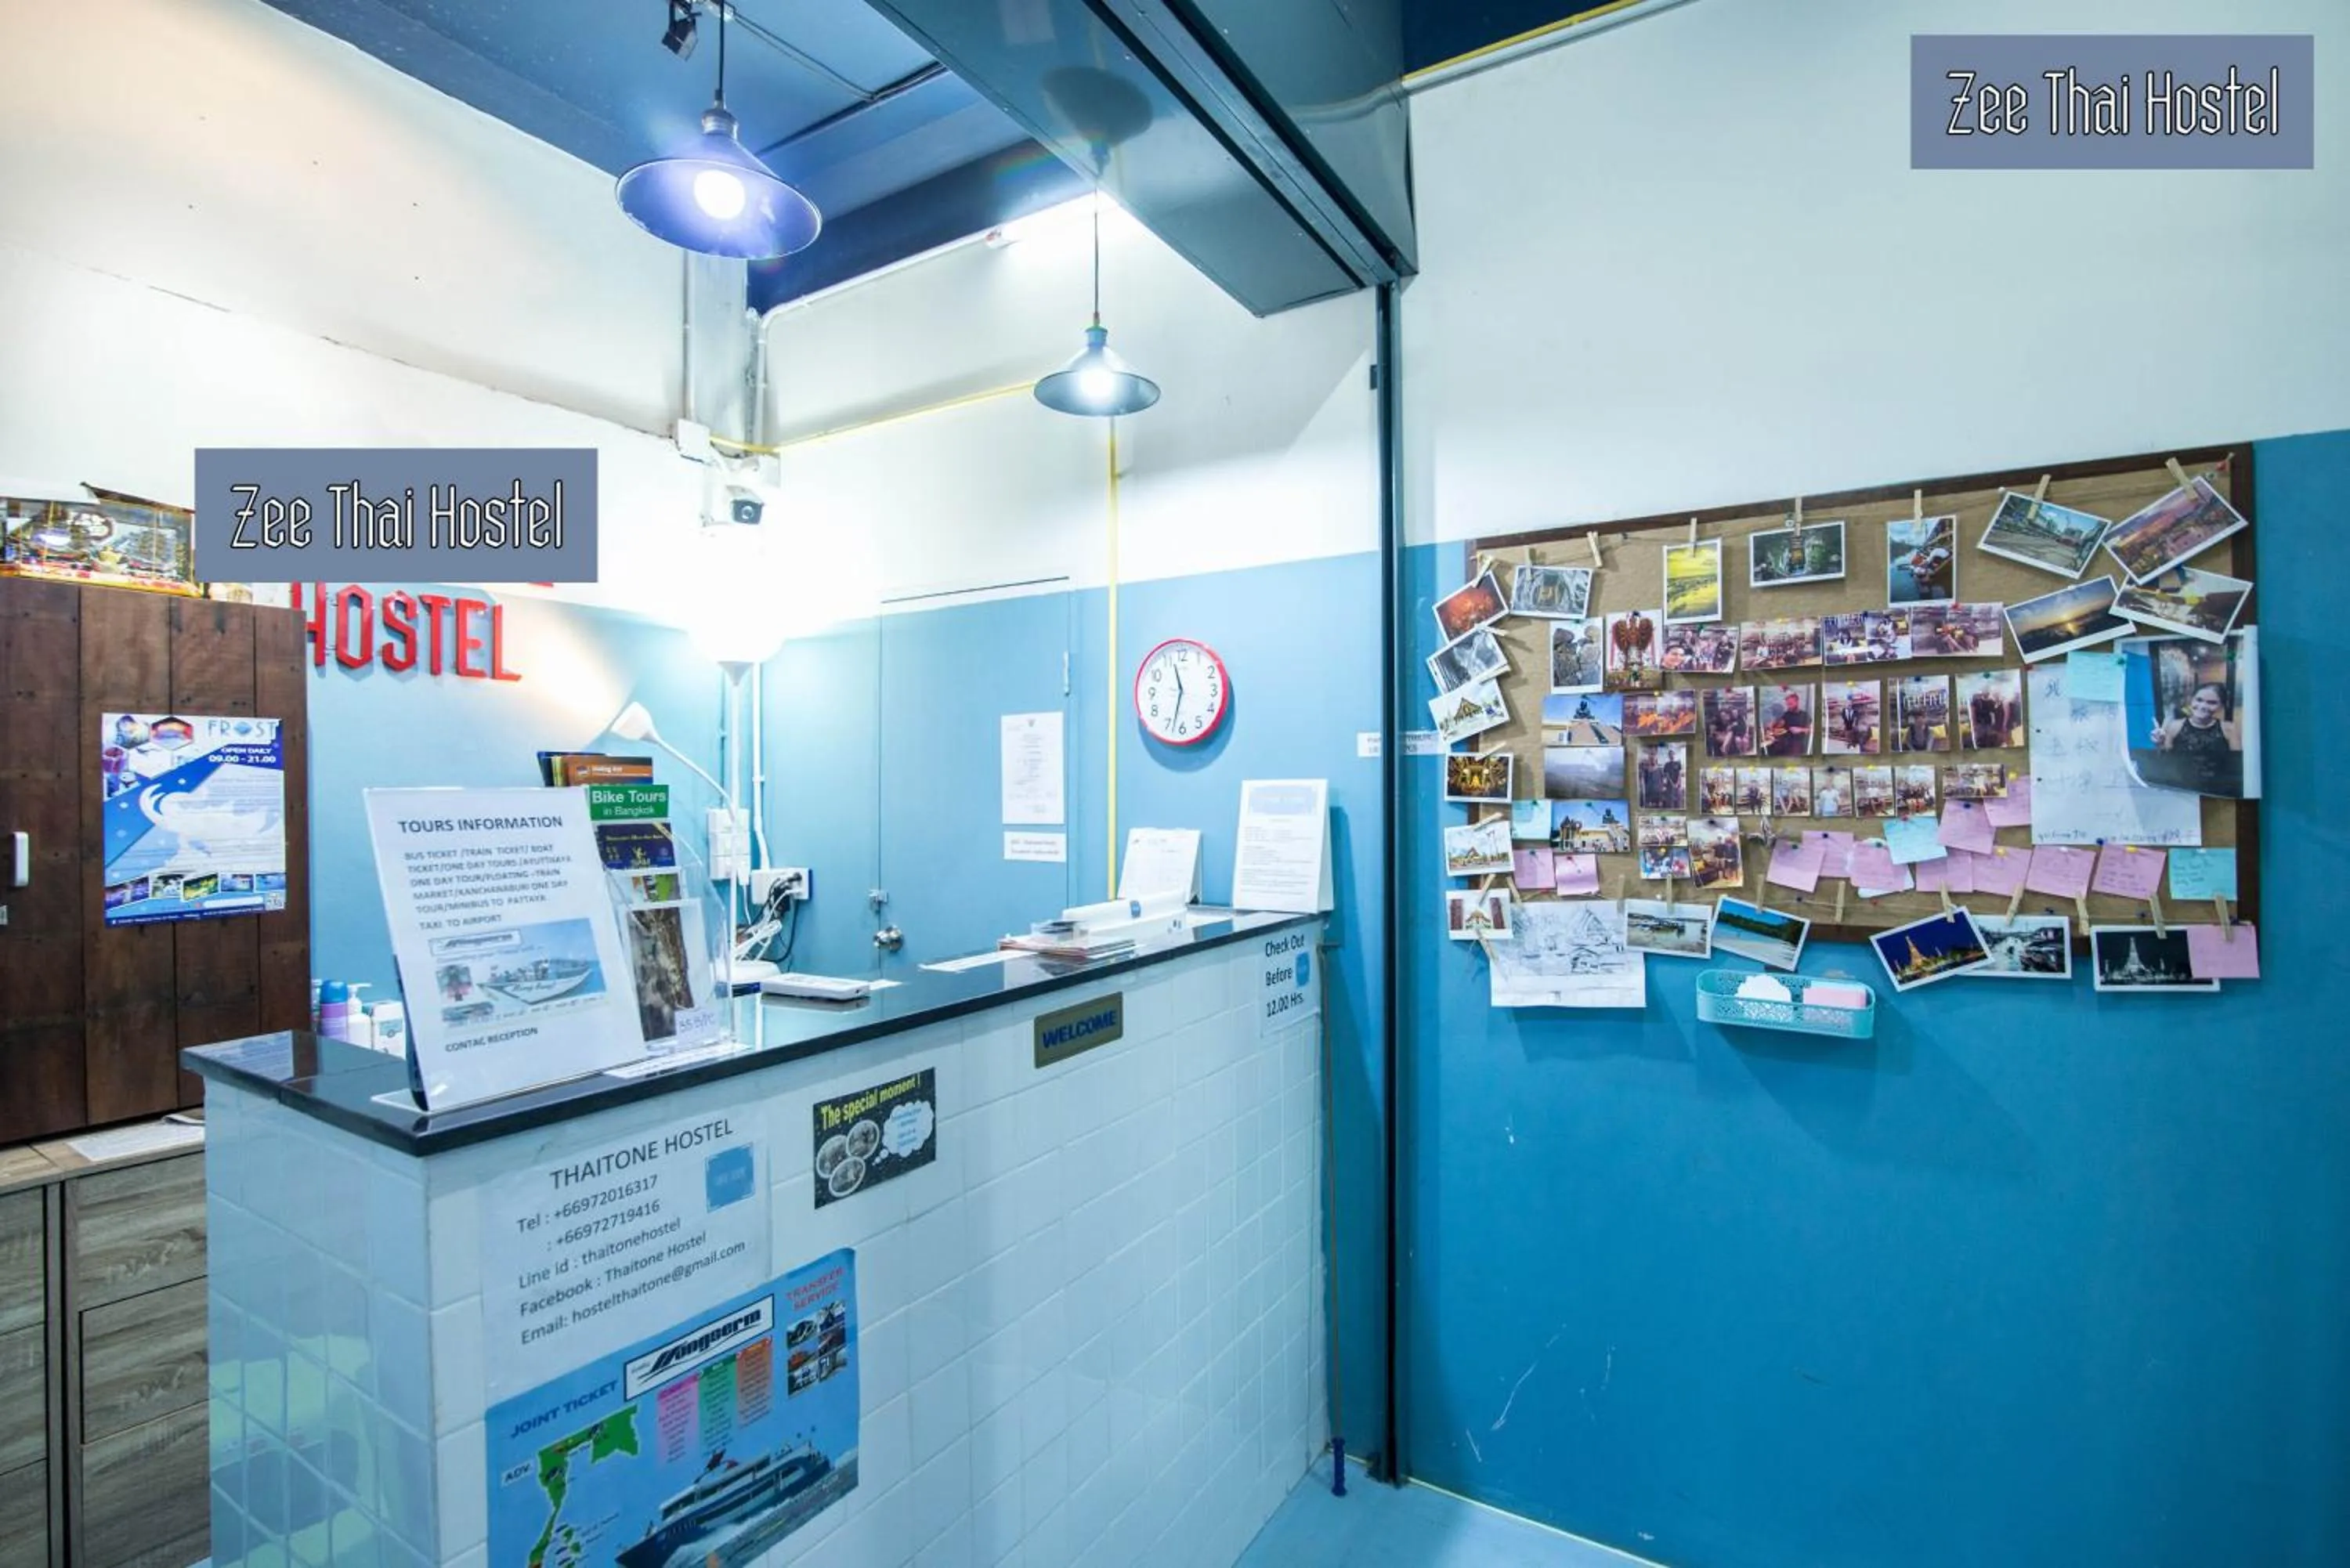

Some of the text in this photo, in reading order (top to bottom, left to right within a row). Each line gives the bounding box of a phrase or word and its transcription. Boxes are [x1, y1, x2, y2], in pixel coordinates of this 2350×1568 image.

[291, 582, 522, 681] HOSTEL
[1176, 649, 1188, 662] 12
[1207, 666, 1215, 679] 2
[1148, 687, 1155, 700] 9
[1209, 683, 1217, 697] 3
[1151, 705, 1158, 717] 8
[1206, 702, 1215, 714] 4
[1165, 717, 1171, 730] 7
[1179, 721, 1186, 735] 6
[1195, 715, 1202, 729] 5
[591, 789, 666, 804] Bike Tours
[603, 805, 655, 817] in Bangkok
[398, 816, 563, 833] TOURS INFORMATION
[404, 851, 425, 861] BUS
[428, 849, 457, 859] TICKET
[467, 860, 485, 869] DAY
[488, 858, 517, 869] TOURS
[410, 877, 431, 887] ONE
[434, 876, 454, 886] DAY
[532, 881, 550, 890] ONE
[491, 898, 504, 906] TO
[447, 918, 461, 927] TO
[463, 914, 502, 925] AIRPORT
[1266, 934, 1304, 957] Check Out
[1266, 968, 1292, 986] Before
[1267, 994, 1289, 1017] 12.00
[488, 1027, 538, 1044] RECEPTION
[1043, 1010, 1115, 1048] WELCOME
[821, 1104, 841, 1131] The
[844, 1089, 878, 1123] special
[880, 1078, 915, 1103] moment
[550, 1118, 732, 1189] THAITONE HOSTEL
[517, 1214, 540, 1234] Tel
[554, 1174, 657, 1219] +66972016317
[556, 1199, 660, 1245] +66972719416
[519, 1266, 550, 1289] Line
[555, 1259, 569, 1275] id
[582, 1218, 681, 1265] thaitonehostel
[520, 1277, 593, 1316] Facebook
[605, 1251, 663, 1283] Thaitone
[667, 1233, 707, 1260] Hostel
[521, 1241, 746, 1345] Email: hostelthaitone@gmail.com
[794, 1283, 837, 1311] SERVICE
[511, 1380, 619, 1439] JOINT TICKET
